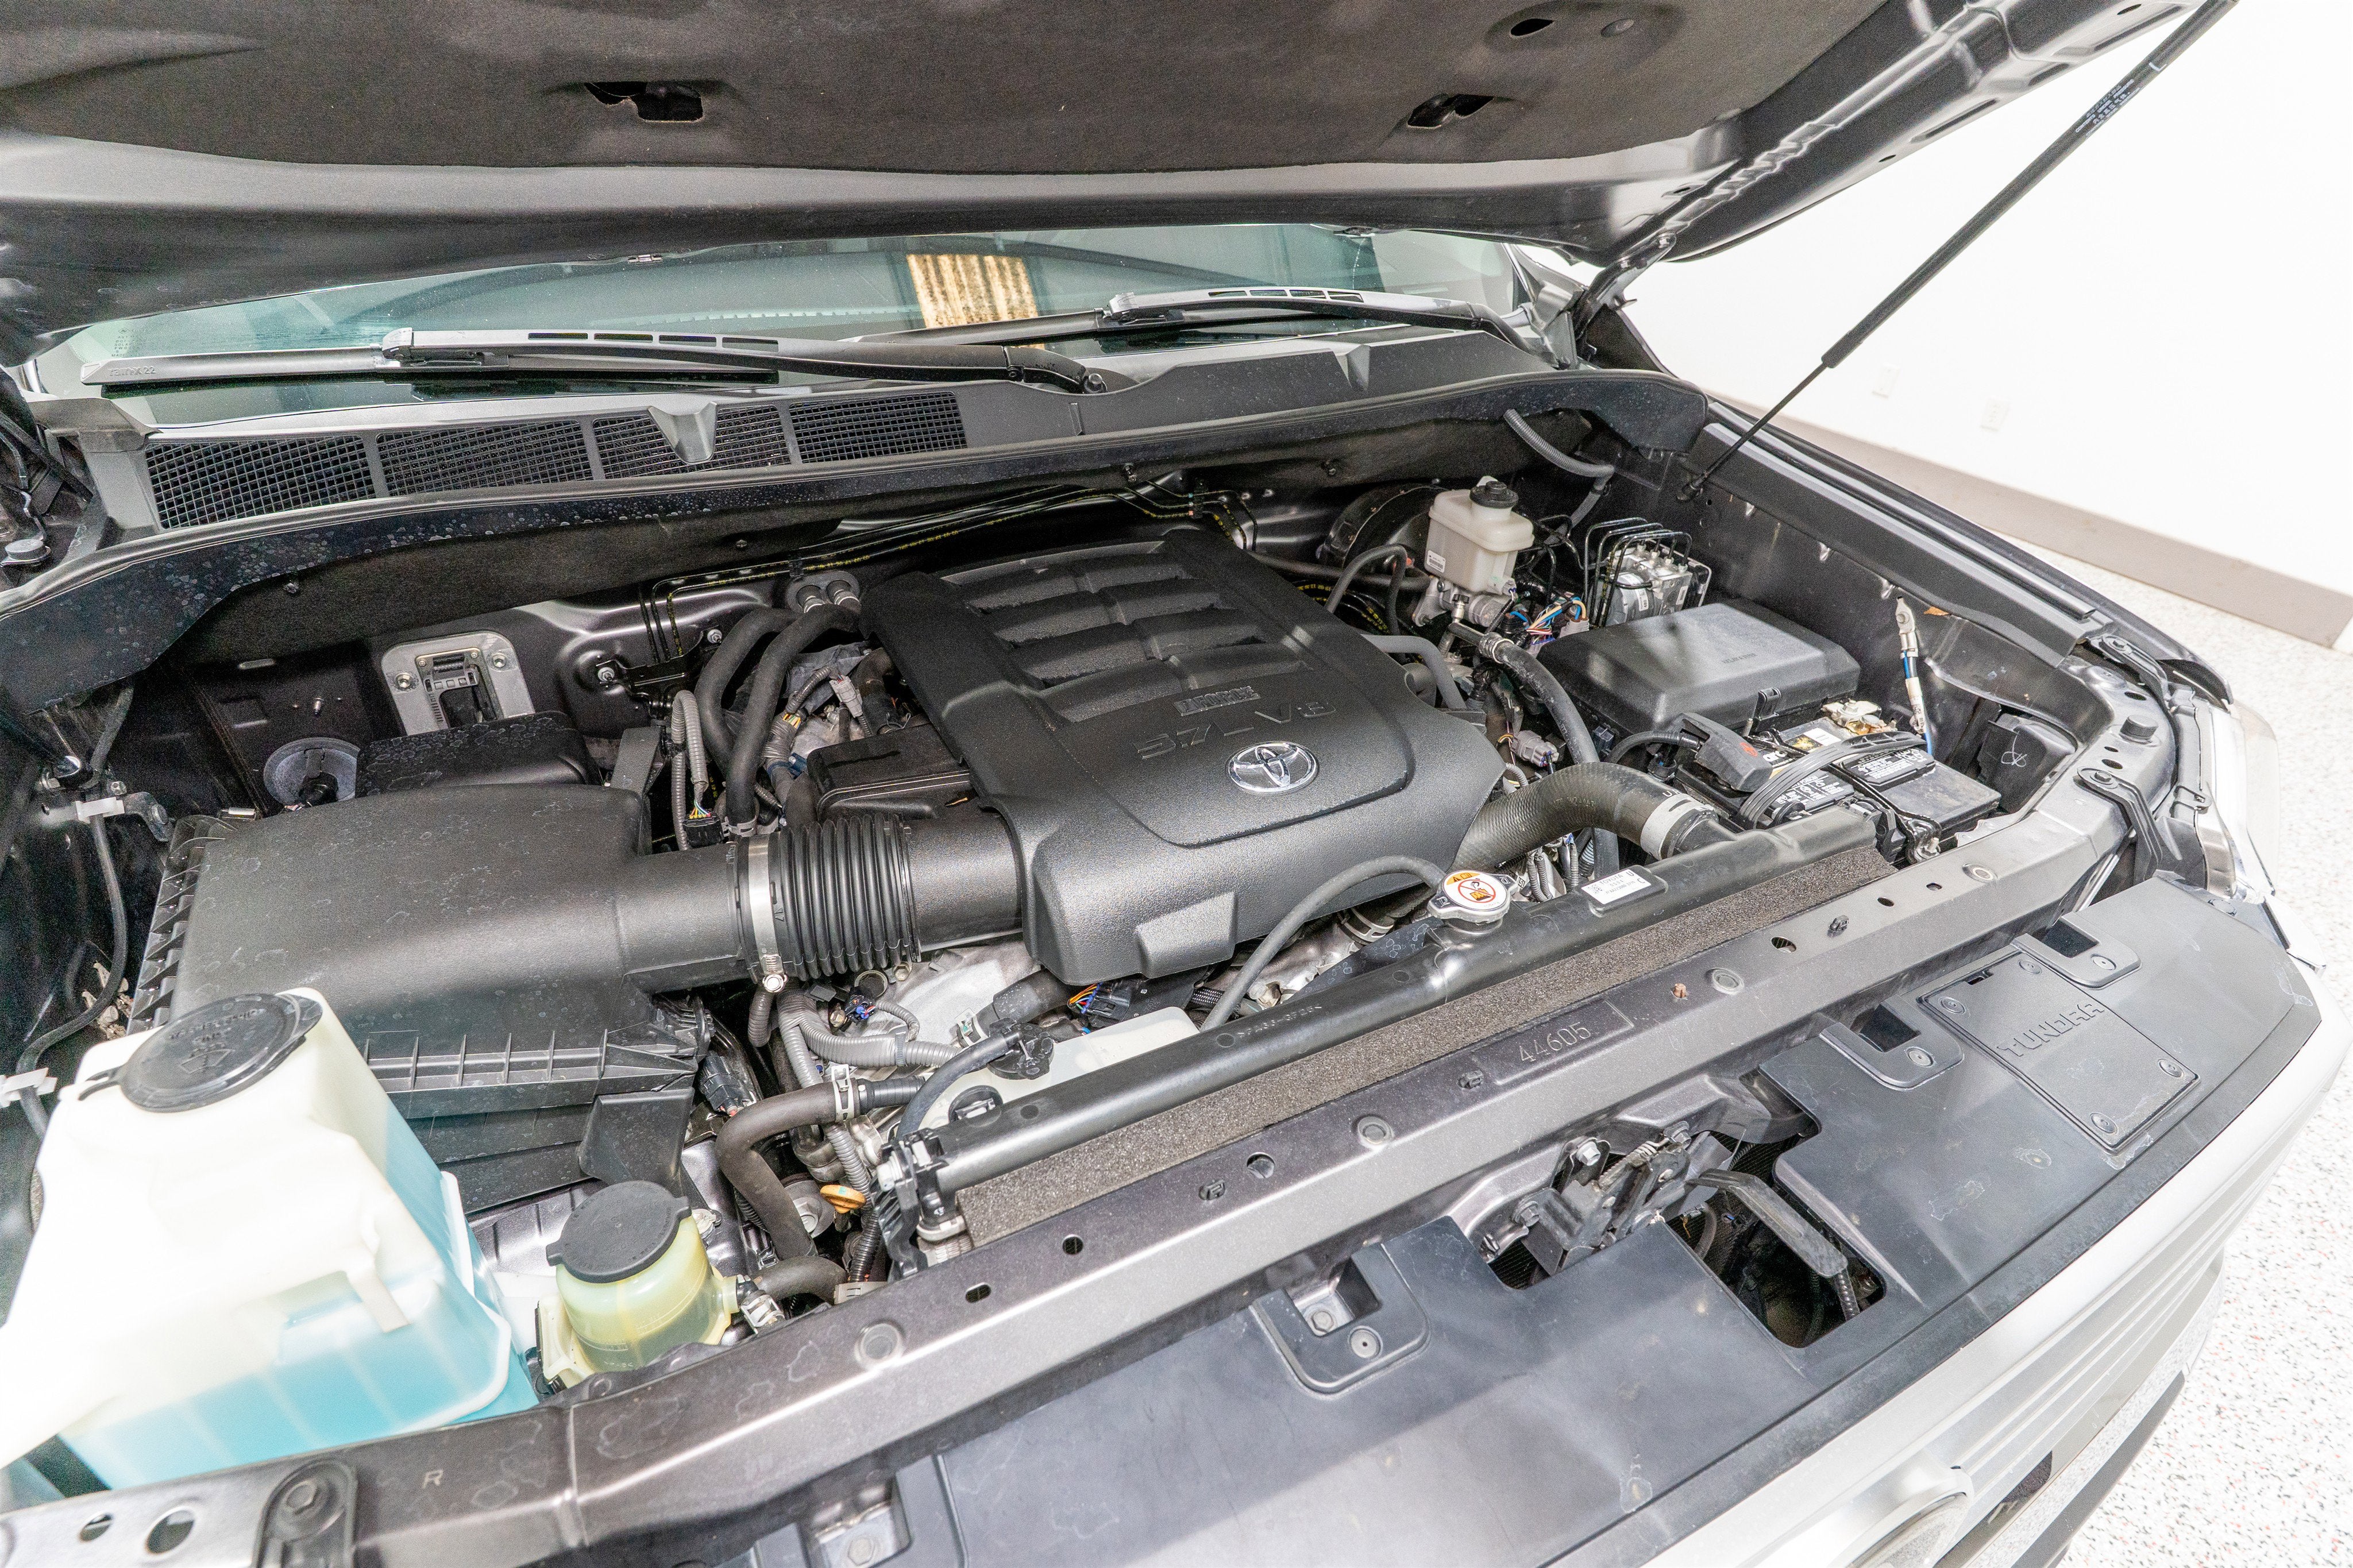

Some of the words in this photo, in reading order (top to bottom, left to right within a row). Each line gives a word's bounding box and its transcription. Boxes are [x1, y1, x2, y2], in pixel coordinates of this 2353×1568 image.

[144, 366, 156, 374] 22
[1599, 874, 1623, 885] TOYOTA
[1997, 1001, 2105, 1057] TUNDRA
[1518, 1022, 1591, 1063] 44605
[422, 1469, 444, 1489] R
